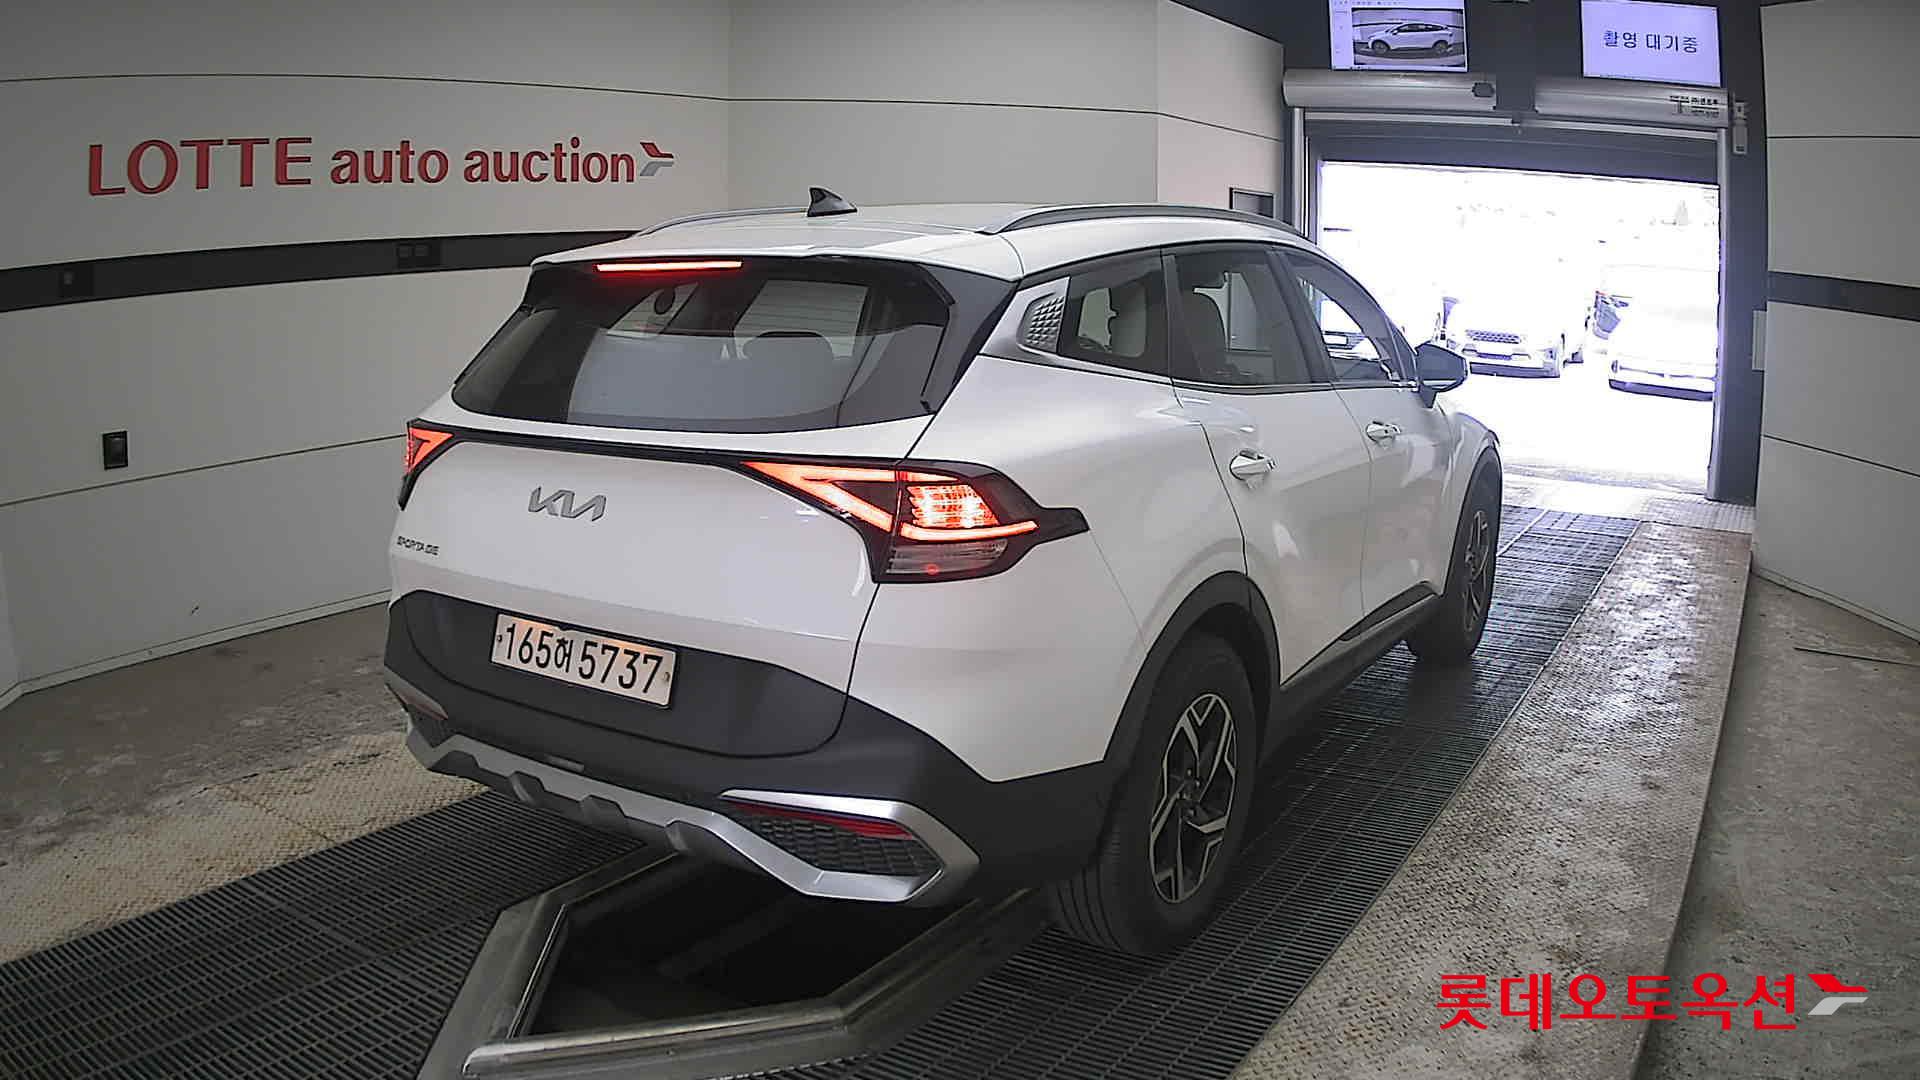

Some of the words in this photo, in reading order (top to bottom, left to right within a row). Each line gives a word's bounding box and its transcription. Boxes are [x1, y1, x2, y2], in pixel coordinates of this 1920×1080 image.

[1645, 33, 1698, 54] 대기중
[89, 138, 311, 196] LOTTE
[330, 143, 450, 184] auto
[463, 138, 637, 183] auction
[528, 486, 608, 522] KIA
[506, 623, 574, 673] 165허
[578, 640, 663, 694] 5737
